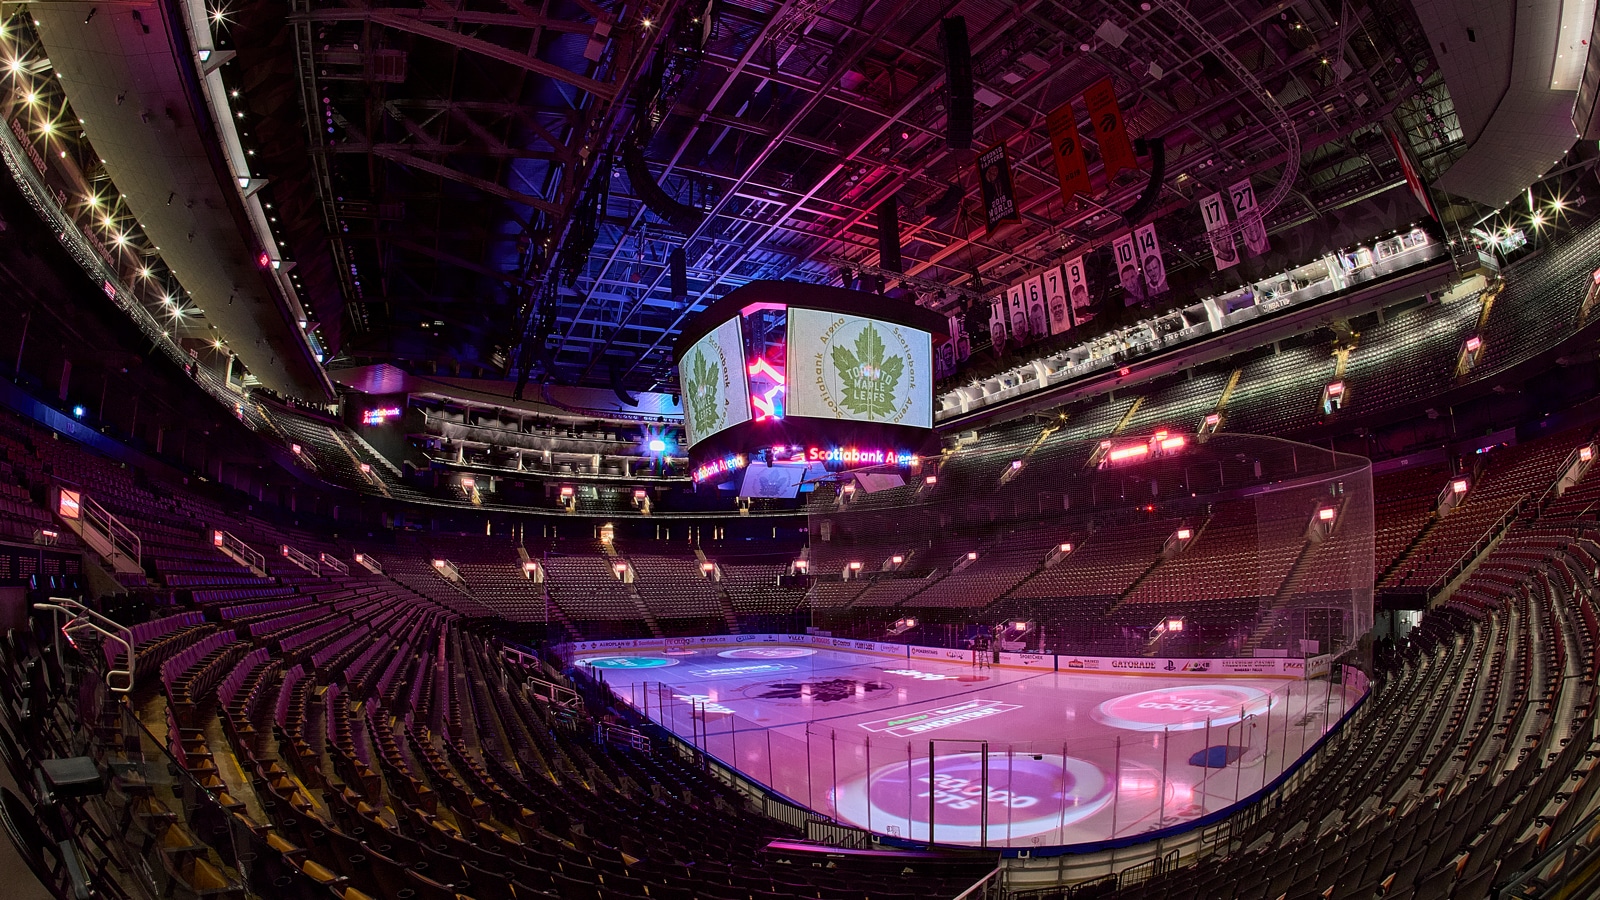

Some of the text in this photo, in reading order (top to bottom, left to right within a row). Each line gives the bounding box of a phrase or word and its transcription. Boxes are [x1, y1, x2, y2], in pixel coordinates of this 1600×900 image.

[12, 118, 48, 171] FRONT STREET
[991, 195, 1006, 208] 2019
[1234, 187, 1254, 212] 27
[989, 199, 1013, 218] WORLD
[1204, 201, 1220, 224] 17
[1140, 232, 1155, 253] 14
[1117, 244, 1132, 264] 10
[1071, 266, 1080, 282] 9
[1049, 276, 1057, 293] 7
[1013, 293, 1020, 308] 4
[1030, 285, 1038, 302] 6
[709, 335, 730, 388] Scotiabank
[815, 318, 845, 418] Scotiabank Arena
[1074, 361, 1098, 372] FOSTER
[893, 327, 916, 423] Scotiabank Arena
[854, 379, 885, 392] MAPLE
[854, 390, 885, 403] LEAFS
[364, 408, 399, 417] Scotiabank
[719, 456, 743, 472] Arena
[810, 448, 918, 465] Scotiabank Arena
[1112, 660, 1156, 669] GATORADE
